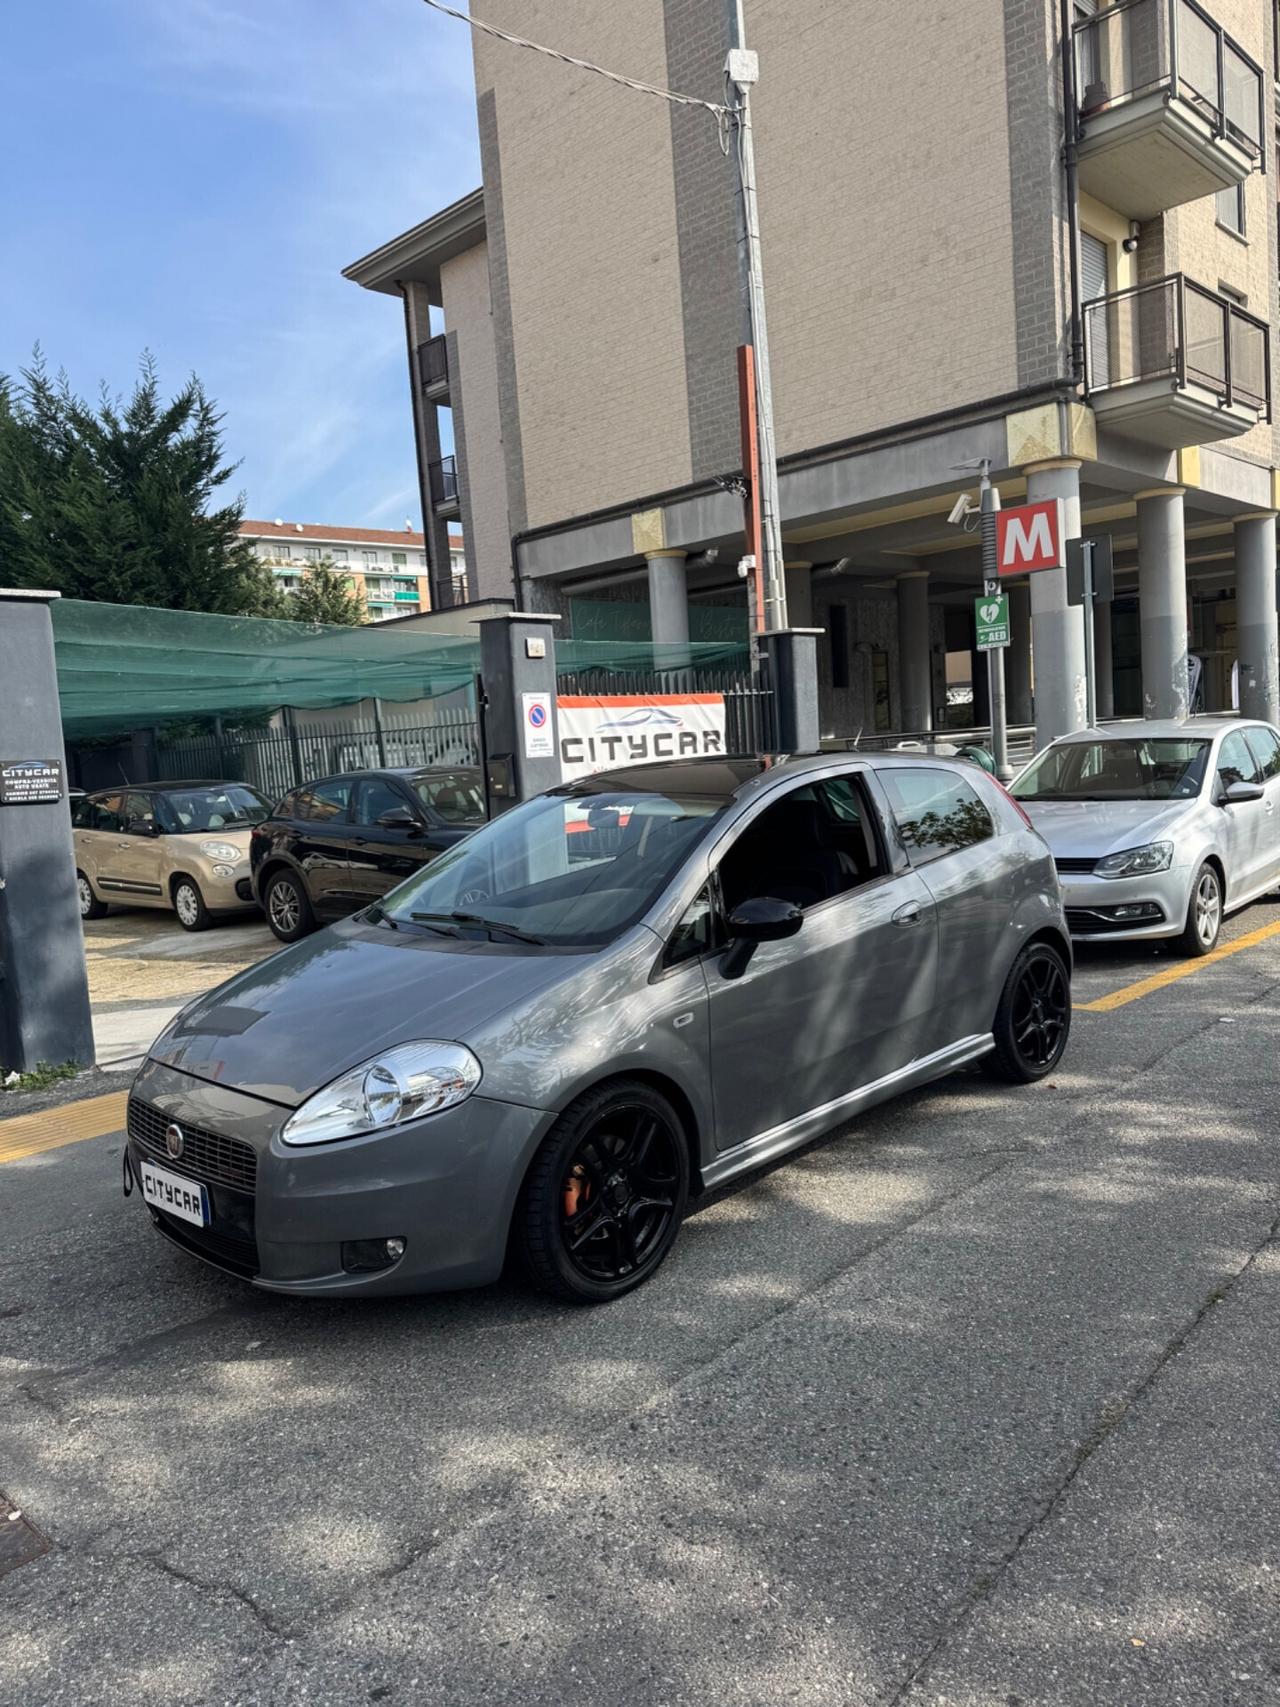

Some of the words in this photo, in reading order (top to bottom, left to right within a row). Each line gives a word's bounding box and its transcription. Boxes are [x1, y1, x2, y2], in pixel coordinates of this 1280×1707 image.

[1003, 512, 1054, 566] M
[988, 630, 1007, 642] AED
[561, 730, 721, 764] CITYCAR
[2, 768, 60, 777] CITYCAR
[145, 1174, 201, 1216] CITYCAR
